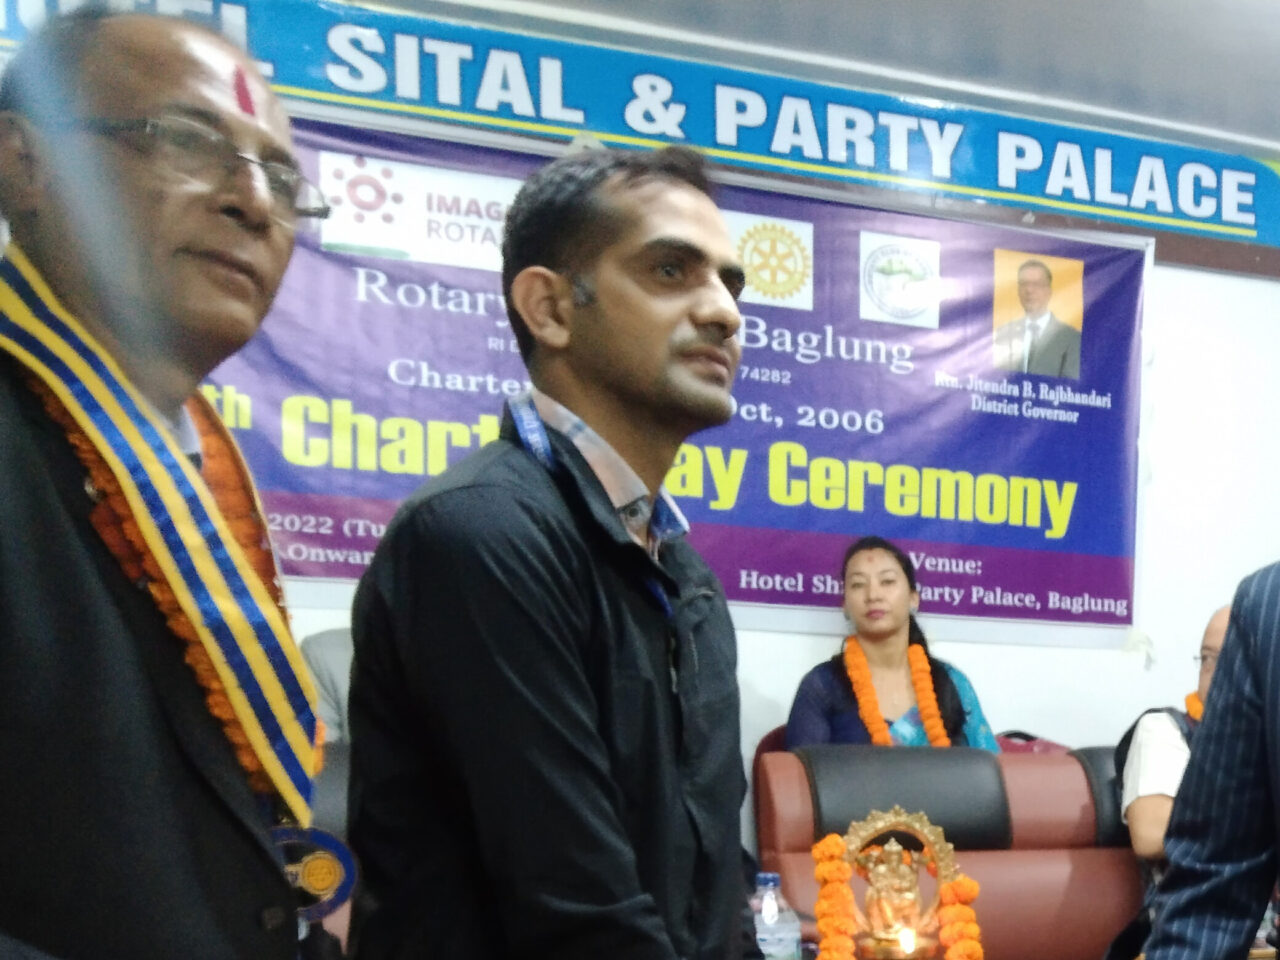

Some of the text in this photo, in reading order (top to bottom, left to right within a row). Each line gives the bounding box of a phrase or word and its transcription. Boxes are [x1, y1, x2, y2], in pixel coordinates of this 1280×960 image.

[326, 23, 585, 124] SITAL
[624, 74, 687, 139] &
[714, 84, 963, 179] PARTY
[998, 132, 1256, 225] PALACE
[738, 315, 914, 374] Baglung
[740, 365, 792, 385] 74282
[967, 374, 1019, 397] Jitendra
[1022, 380, 1035, 399] B.
[1038, 383, 1112, 409] Rajbhandari
[797, 405, 884, 434] 2006
[971, 394, 1079, 423] District Governor
[768, 440, 1078, 539] Ceremony
[267, 514, 333, 534] 2022
[908, 551, 982, 575] Venue:
[739, 569, 803, 592] Hotel
[971, 585, 1041, 610] Palace,
[1048, 591, 1128, 617] Baglung
